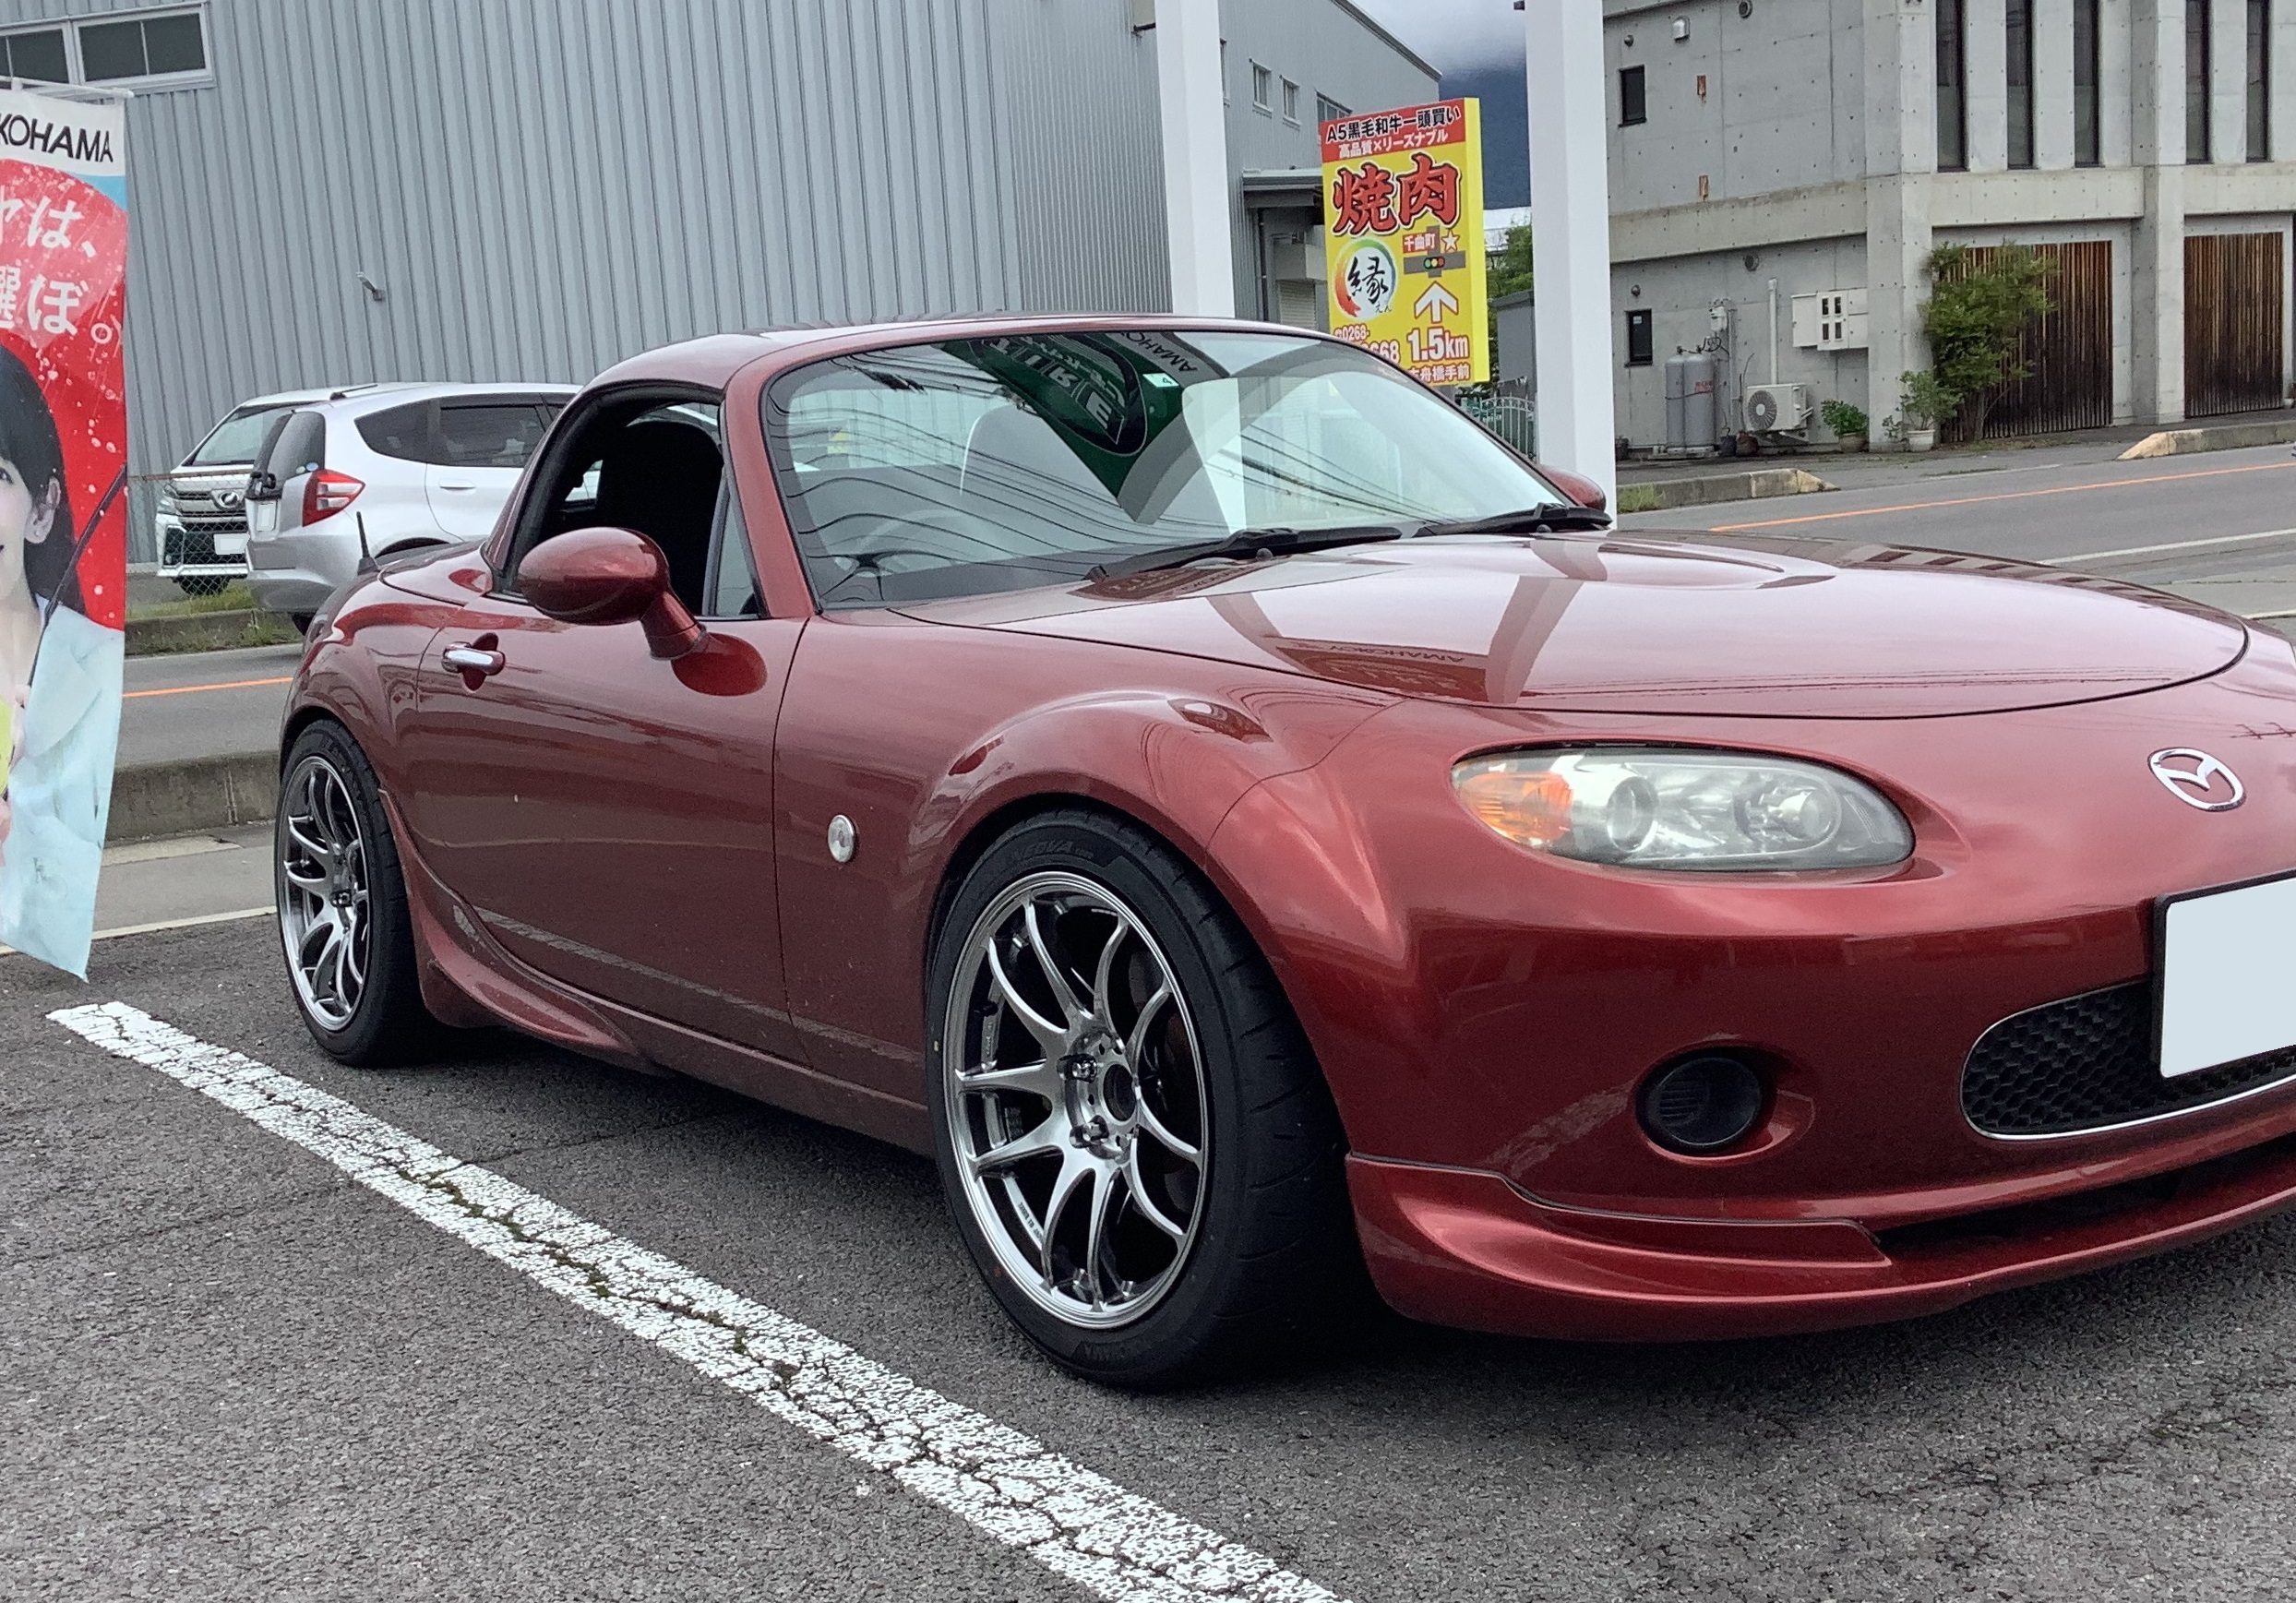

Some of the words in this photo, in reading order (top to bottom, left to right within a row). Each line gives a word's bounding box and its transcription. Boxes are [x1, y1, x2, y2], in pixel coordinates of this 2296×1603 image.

[1327, 107, 1460, 142] A5黒毛和牛一頭買い
[1339, 129, 1448, 158] 高品質×リーズナブル
[1333, 152, 1459, 234] 焼肉
[1404, 233, 1435, 252] 千曲町
[1347, 257, 1389, 305] 縁
[1406, 326, 1470, 362] 1.5km
